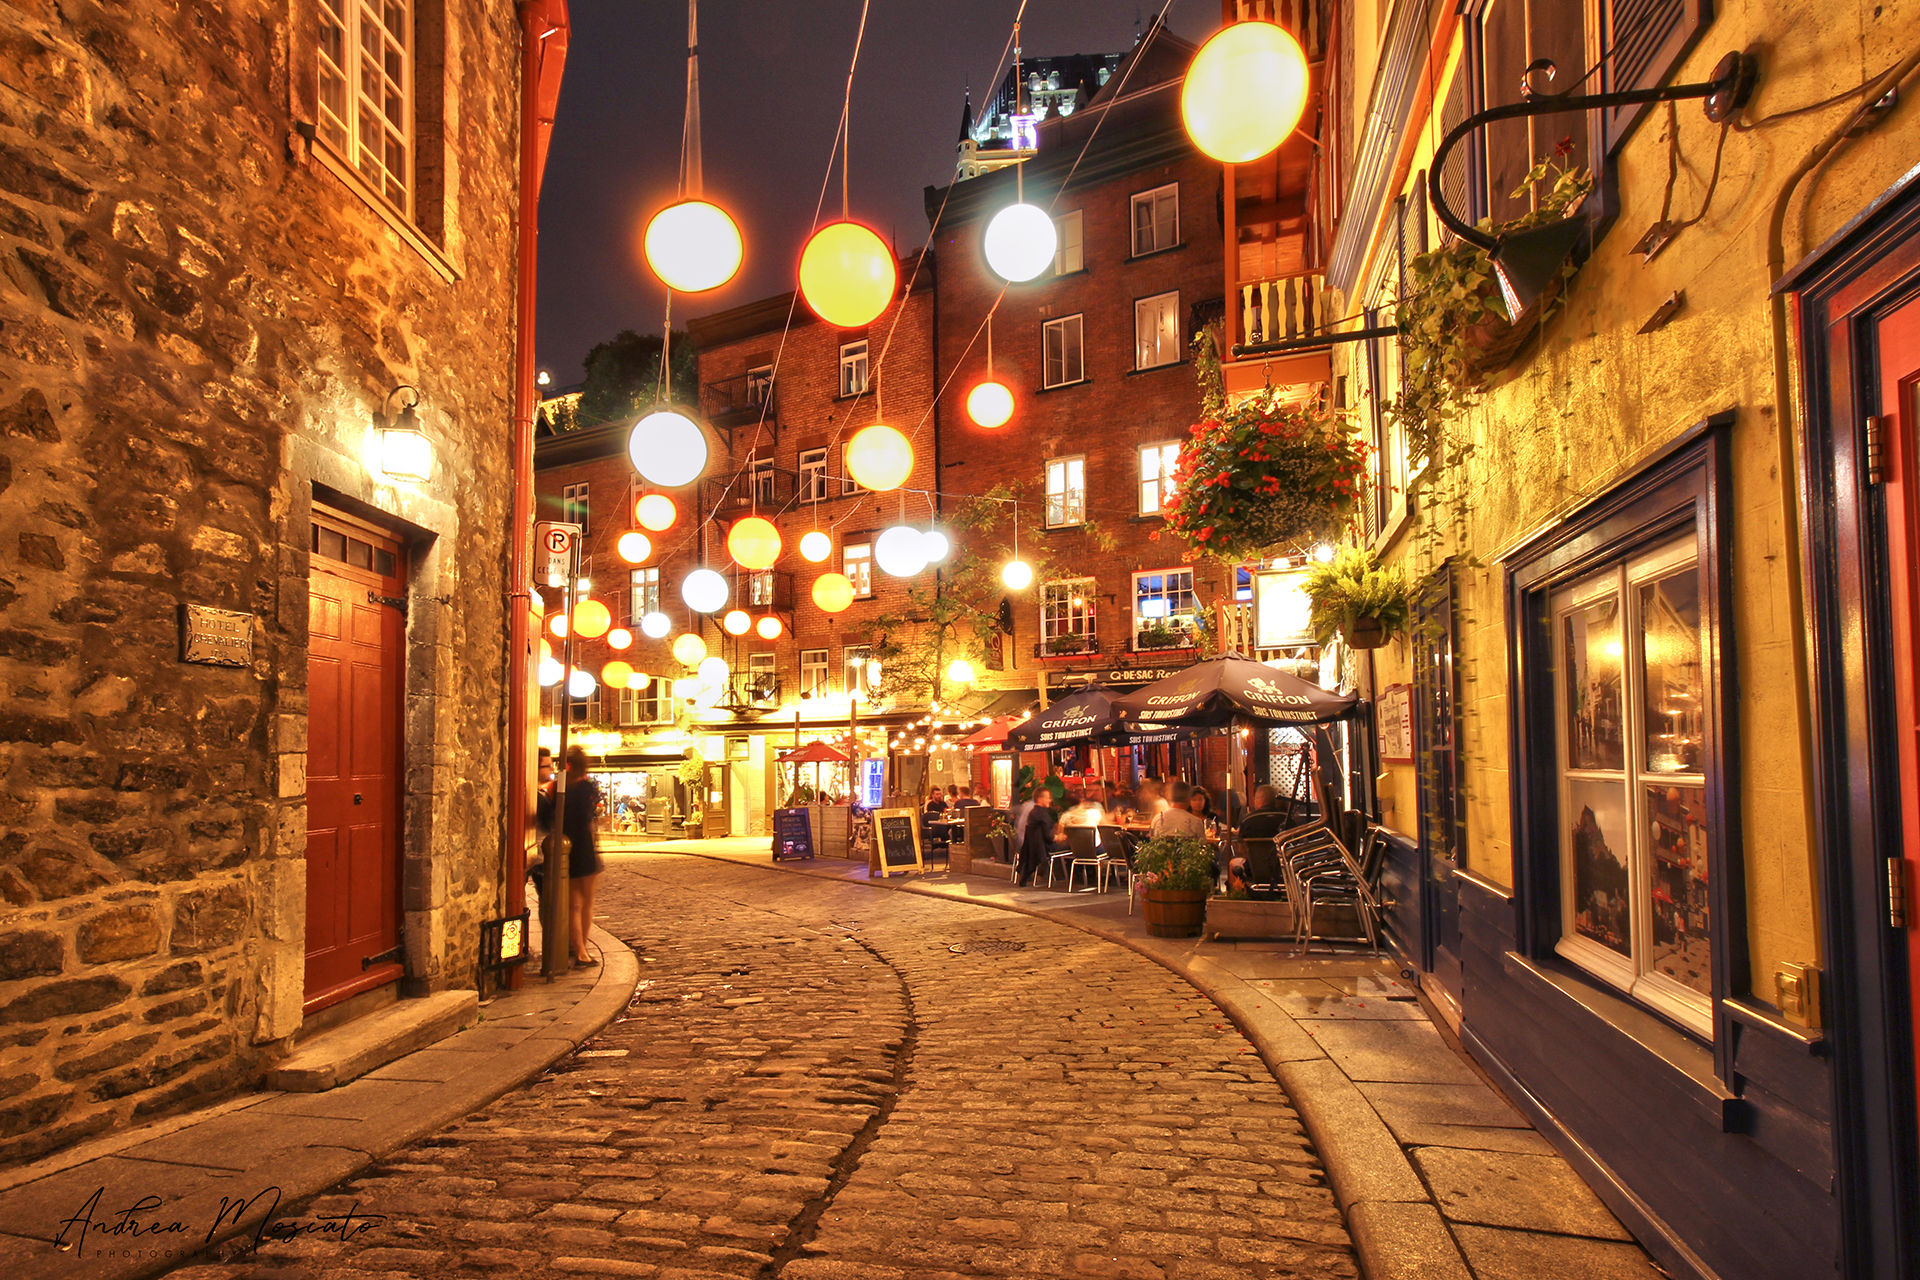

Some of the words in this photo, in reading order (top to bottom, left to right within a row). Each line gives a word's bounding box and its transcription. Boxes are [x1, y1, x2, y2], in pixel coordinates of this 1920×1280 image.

[548, 557, 565, 565] DANS
[200, 617, 240, 632] HOTEL
[193, 631, 247, 649] CHEVALIER
[1147, 691, 1200, 705] GRIFFON
[1243, 690, 1312, 705] GRIFFON
[1252, 705, 1269, 717] SUIS
[1268, 708, 1282, 719] TON
[1281, 710, 1318, 720] INSTINCT
[1041, 714, 1098, 729] GRIFFON
[1040, 732, 1054, 741] SUIS
[1054, 731, 1066, 740] TON
[1065, 727, 1094, 739] INSTINCT
[1129, 736, 1142, 744] SUIS
[1142, 735, 1153, 743] TON
[1152, 733, 1178, 742] INSTINCT
